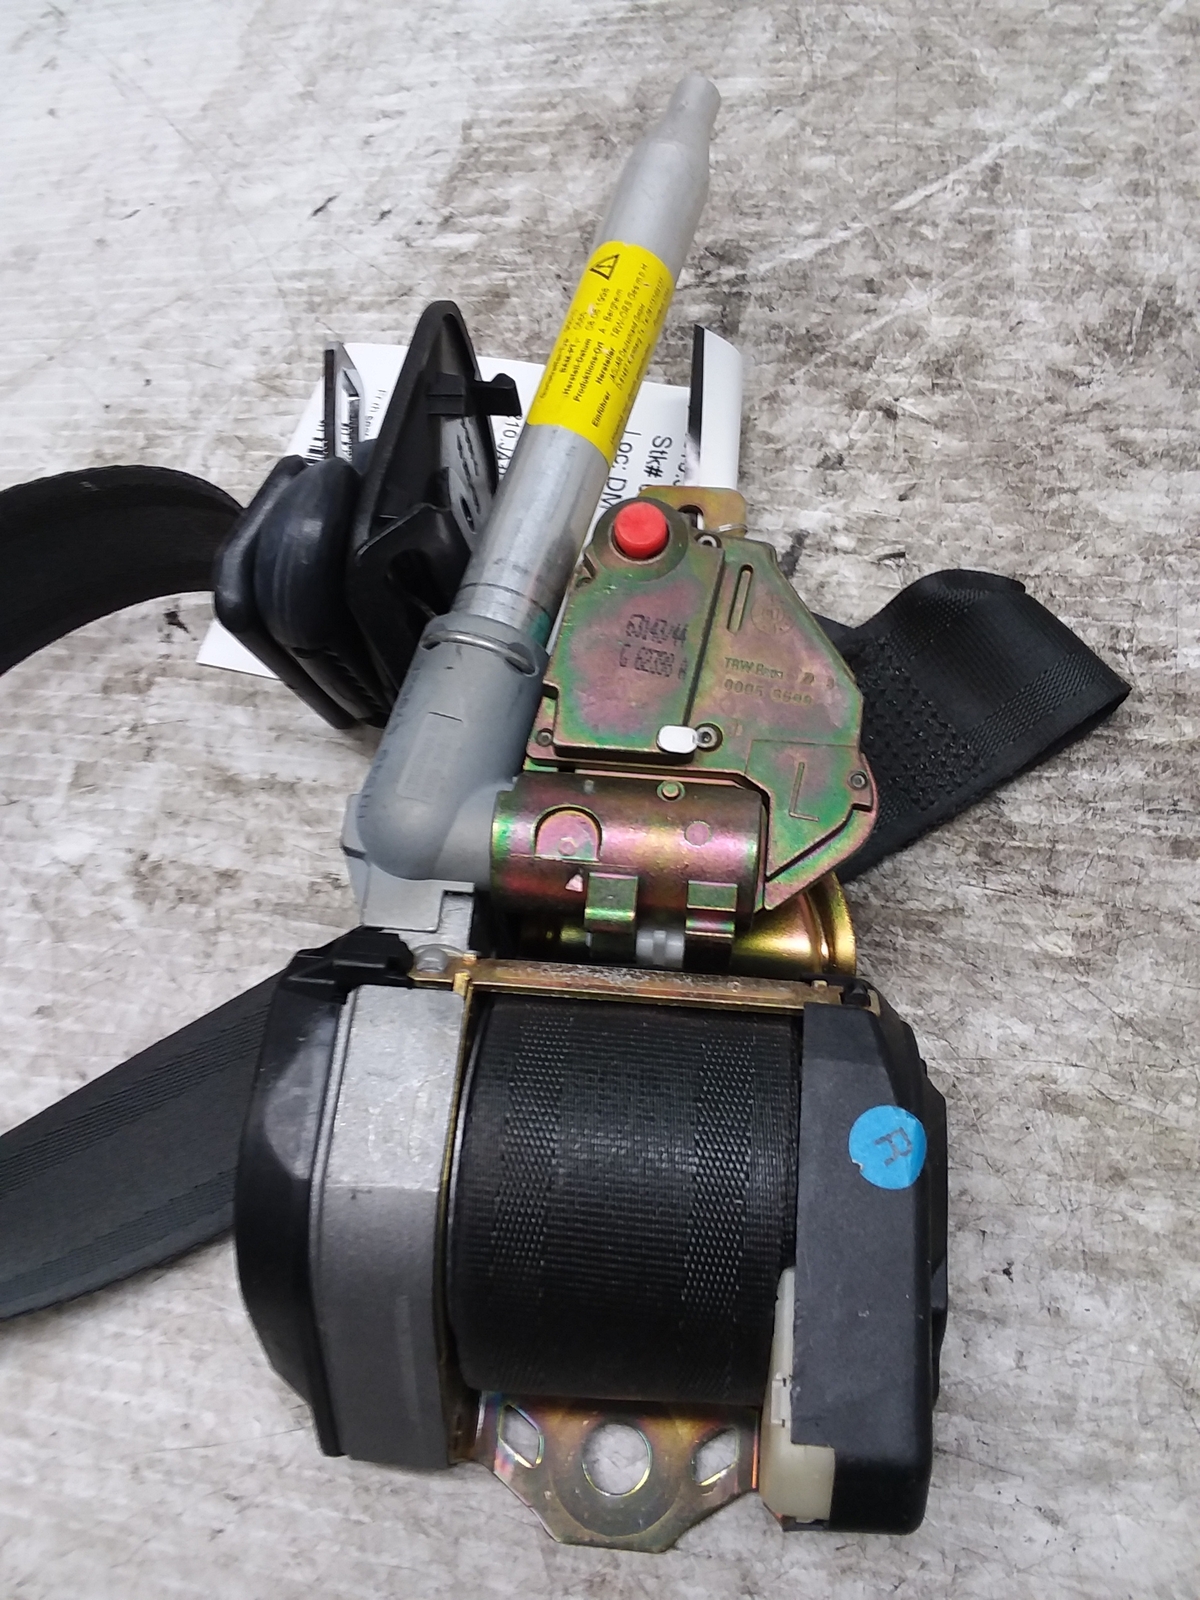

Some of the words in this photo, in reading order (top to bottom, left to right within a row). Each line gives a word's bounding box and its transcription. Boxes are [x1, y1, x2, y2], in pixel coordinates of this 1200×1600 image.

[572, 340, 604, 402] Produktions-Ort
[594, 346, 615, 384] Hersteller
[591, 390, 611, 427] Einführer
[644, 435, 673, 478] Stk#
[873, 1125, 915, 1167] R
